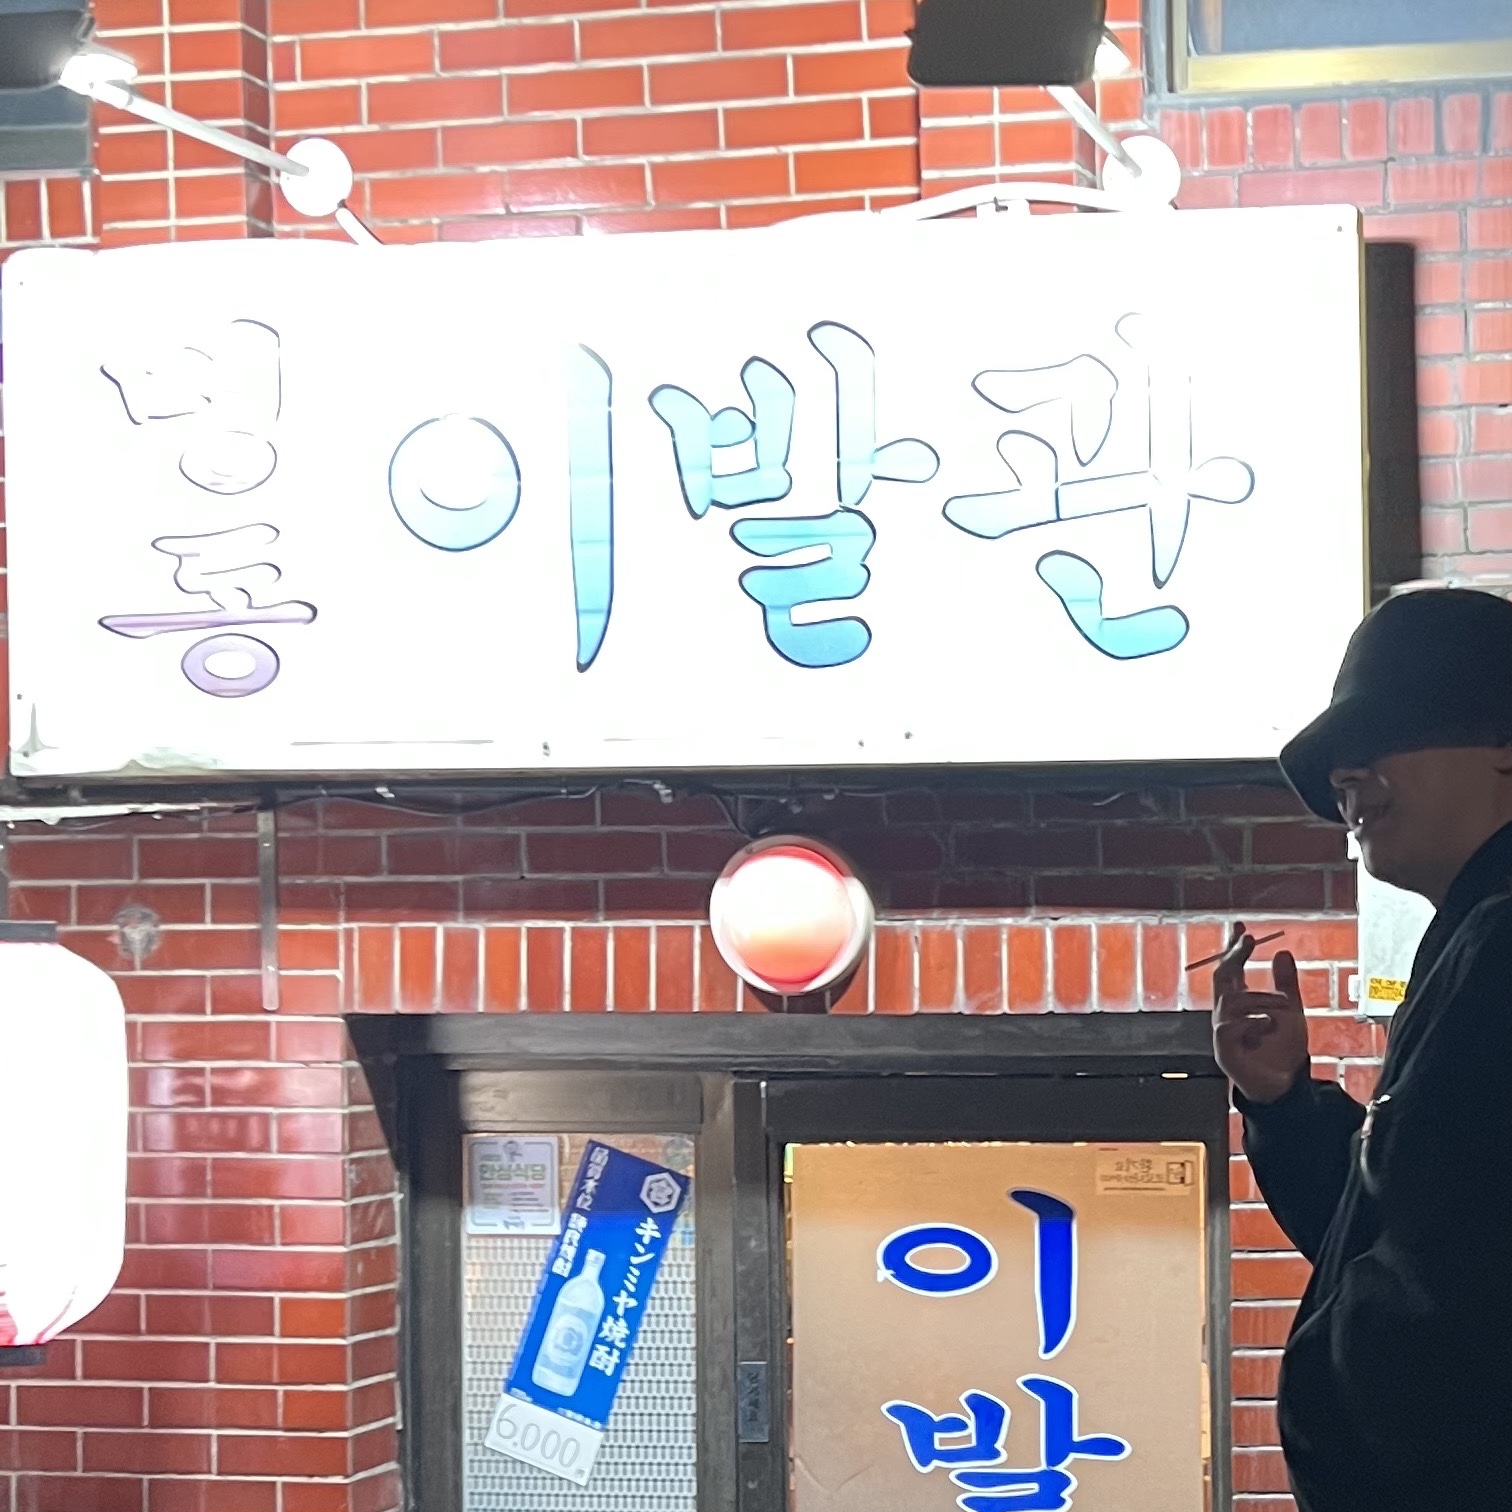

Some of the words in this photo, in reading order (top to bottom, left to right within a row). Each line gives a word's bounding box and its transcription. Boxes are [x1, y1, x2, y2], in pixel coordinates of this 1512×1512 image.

[388, 311, 1255, 673] 이발관
[587, 1216, 663, 1377] キンミヤ焼酎
